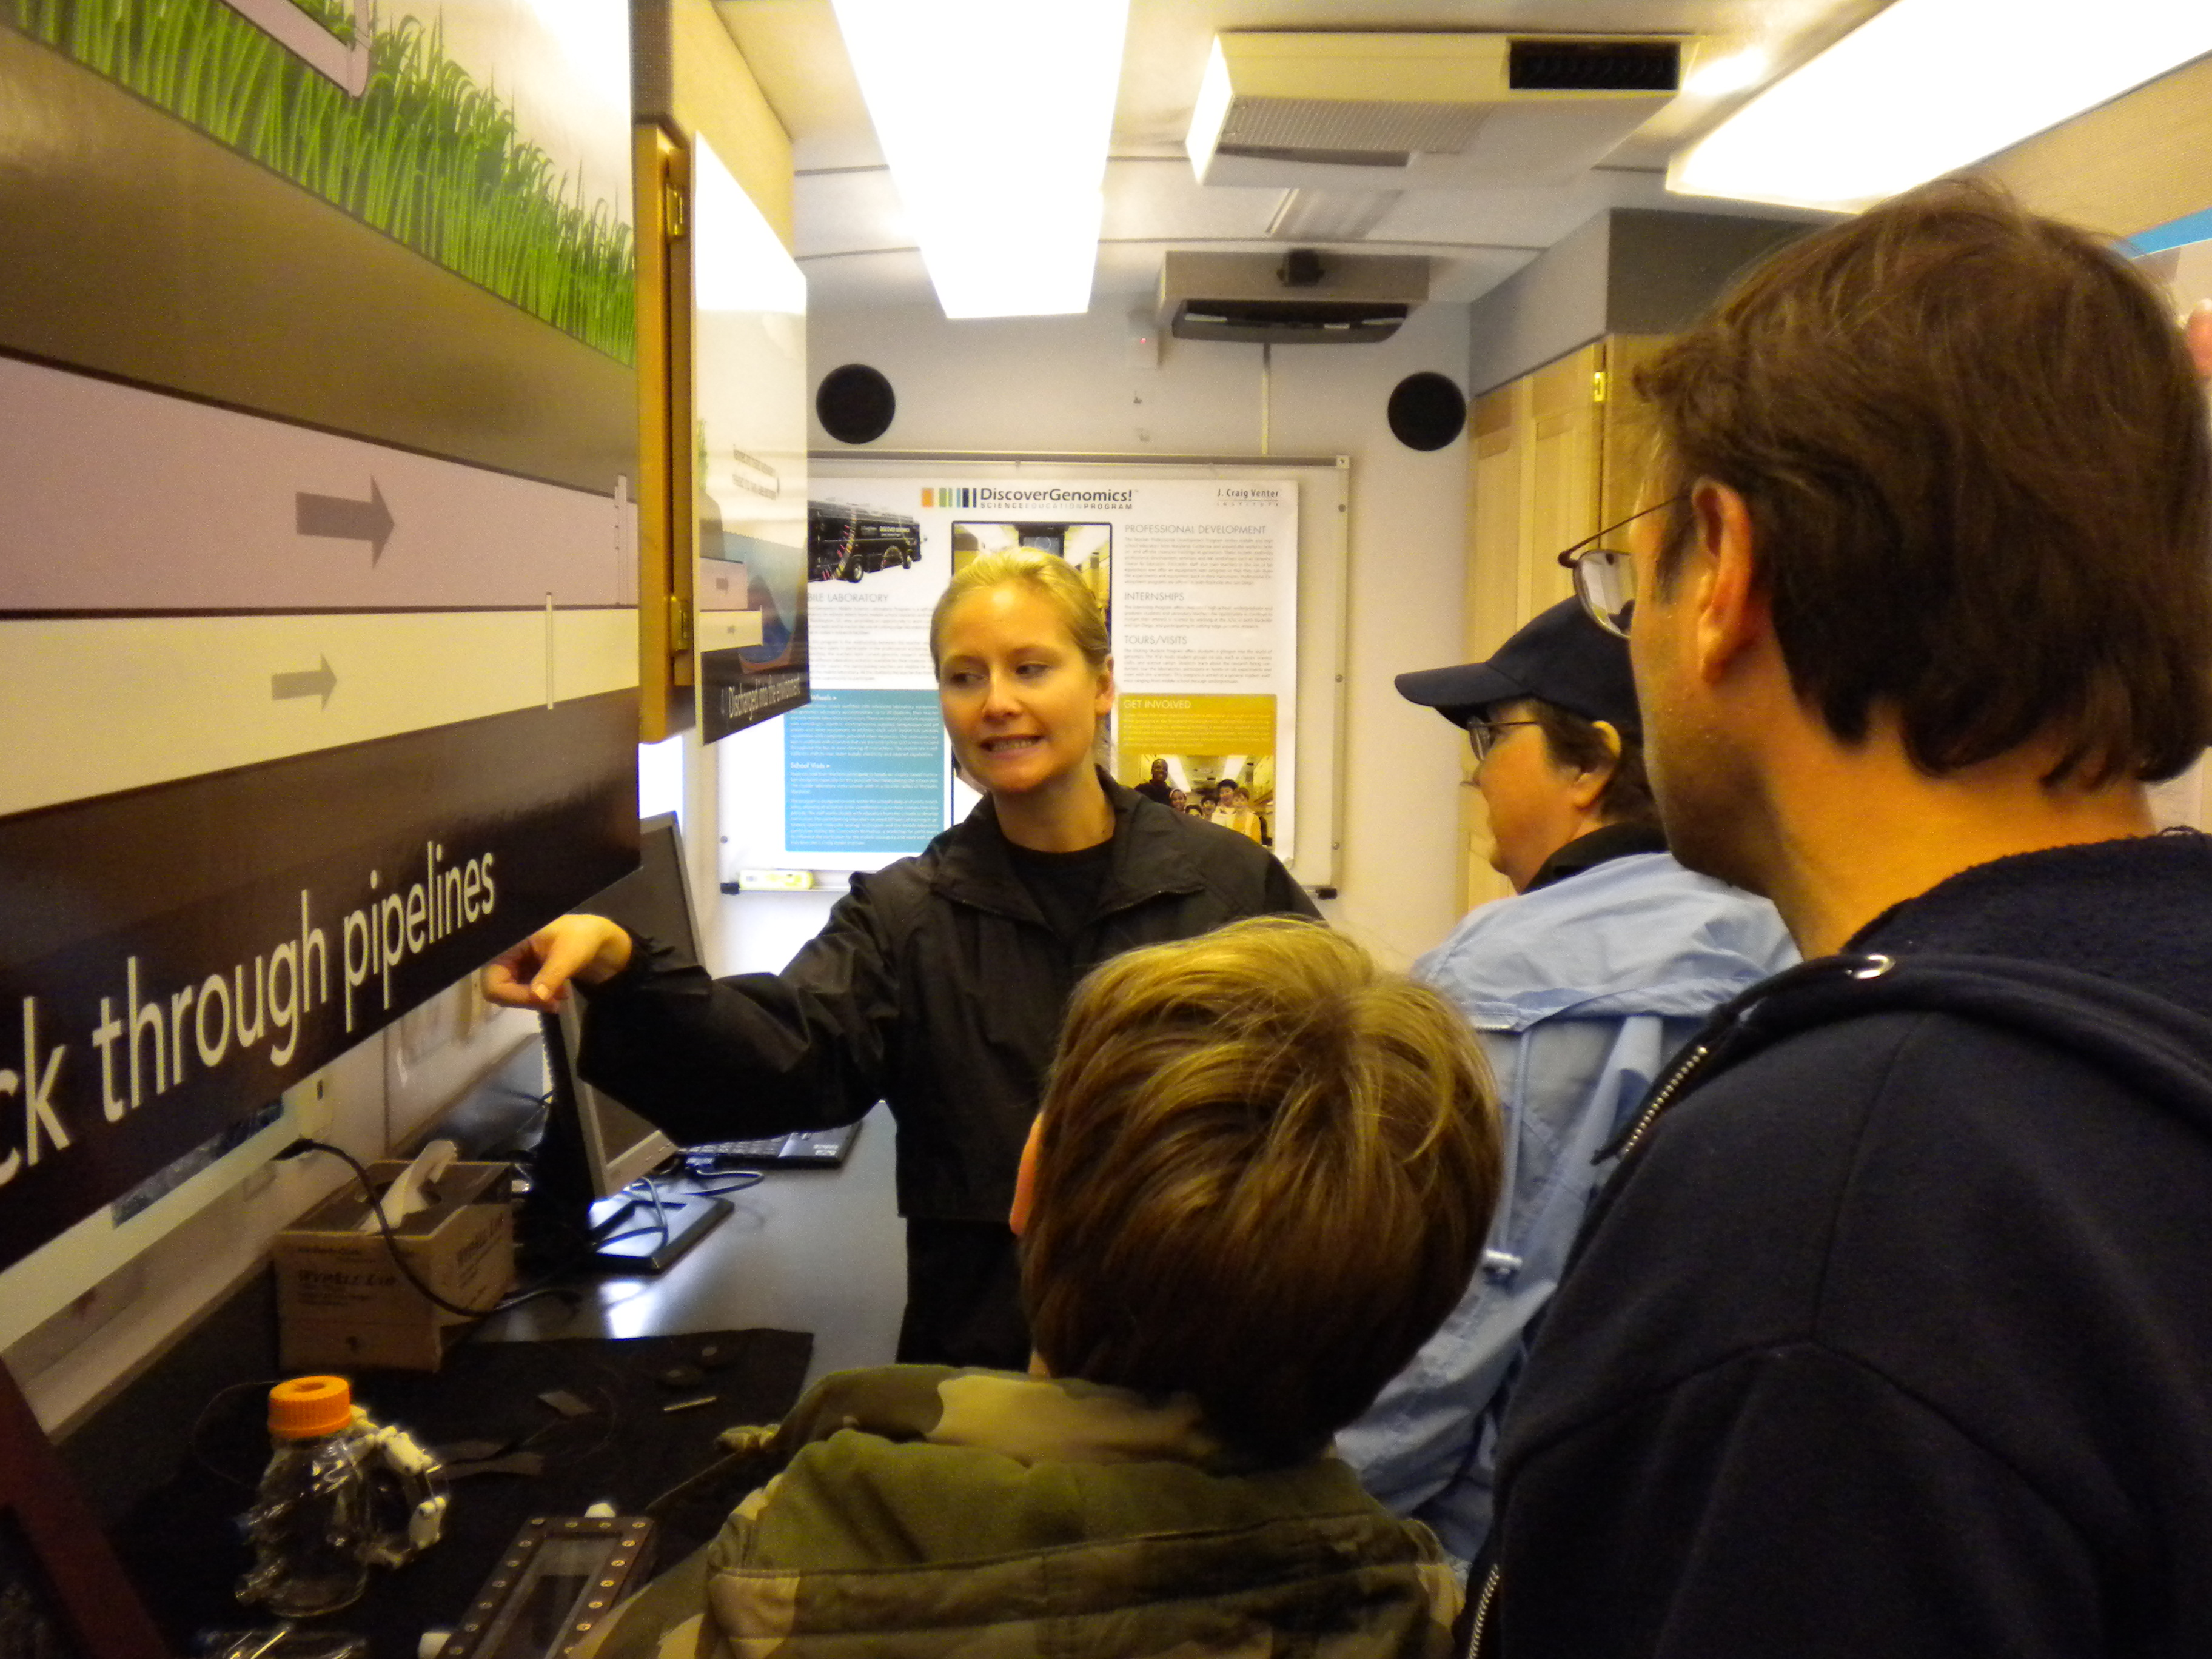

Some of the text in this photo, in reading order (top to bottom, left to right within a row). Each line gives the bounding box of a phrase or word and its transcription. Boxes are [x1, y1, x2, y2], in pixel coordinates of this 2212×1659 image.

[980, 488, 1132, 502] DiscoverGenomics!
[1226, 489, 1248, 499] Craig
[1251, 489, 1278, 497] Venter
[1125, 524, 1266, 534] PROFESSIONAL DEVELOPMENT
[827, 593, 889, 602] LABORATORY
[1124, 592, 1185, 601] INTERNSHIPS
[1124, 635, 1187, 645] TOURS/VISITS
[1124, 700, 1191, 709] GET INVOLVED
[92, 889, 328, 1124] through
[343, 840, 495, 1033] pipelines
